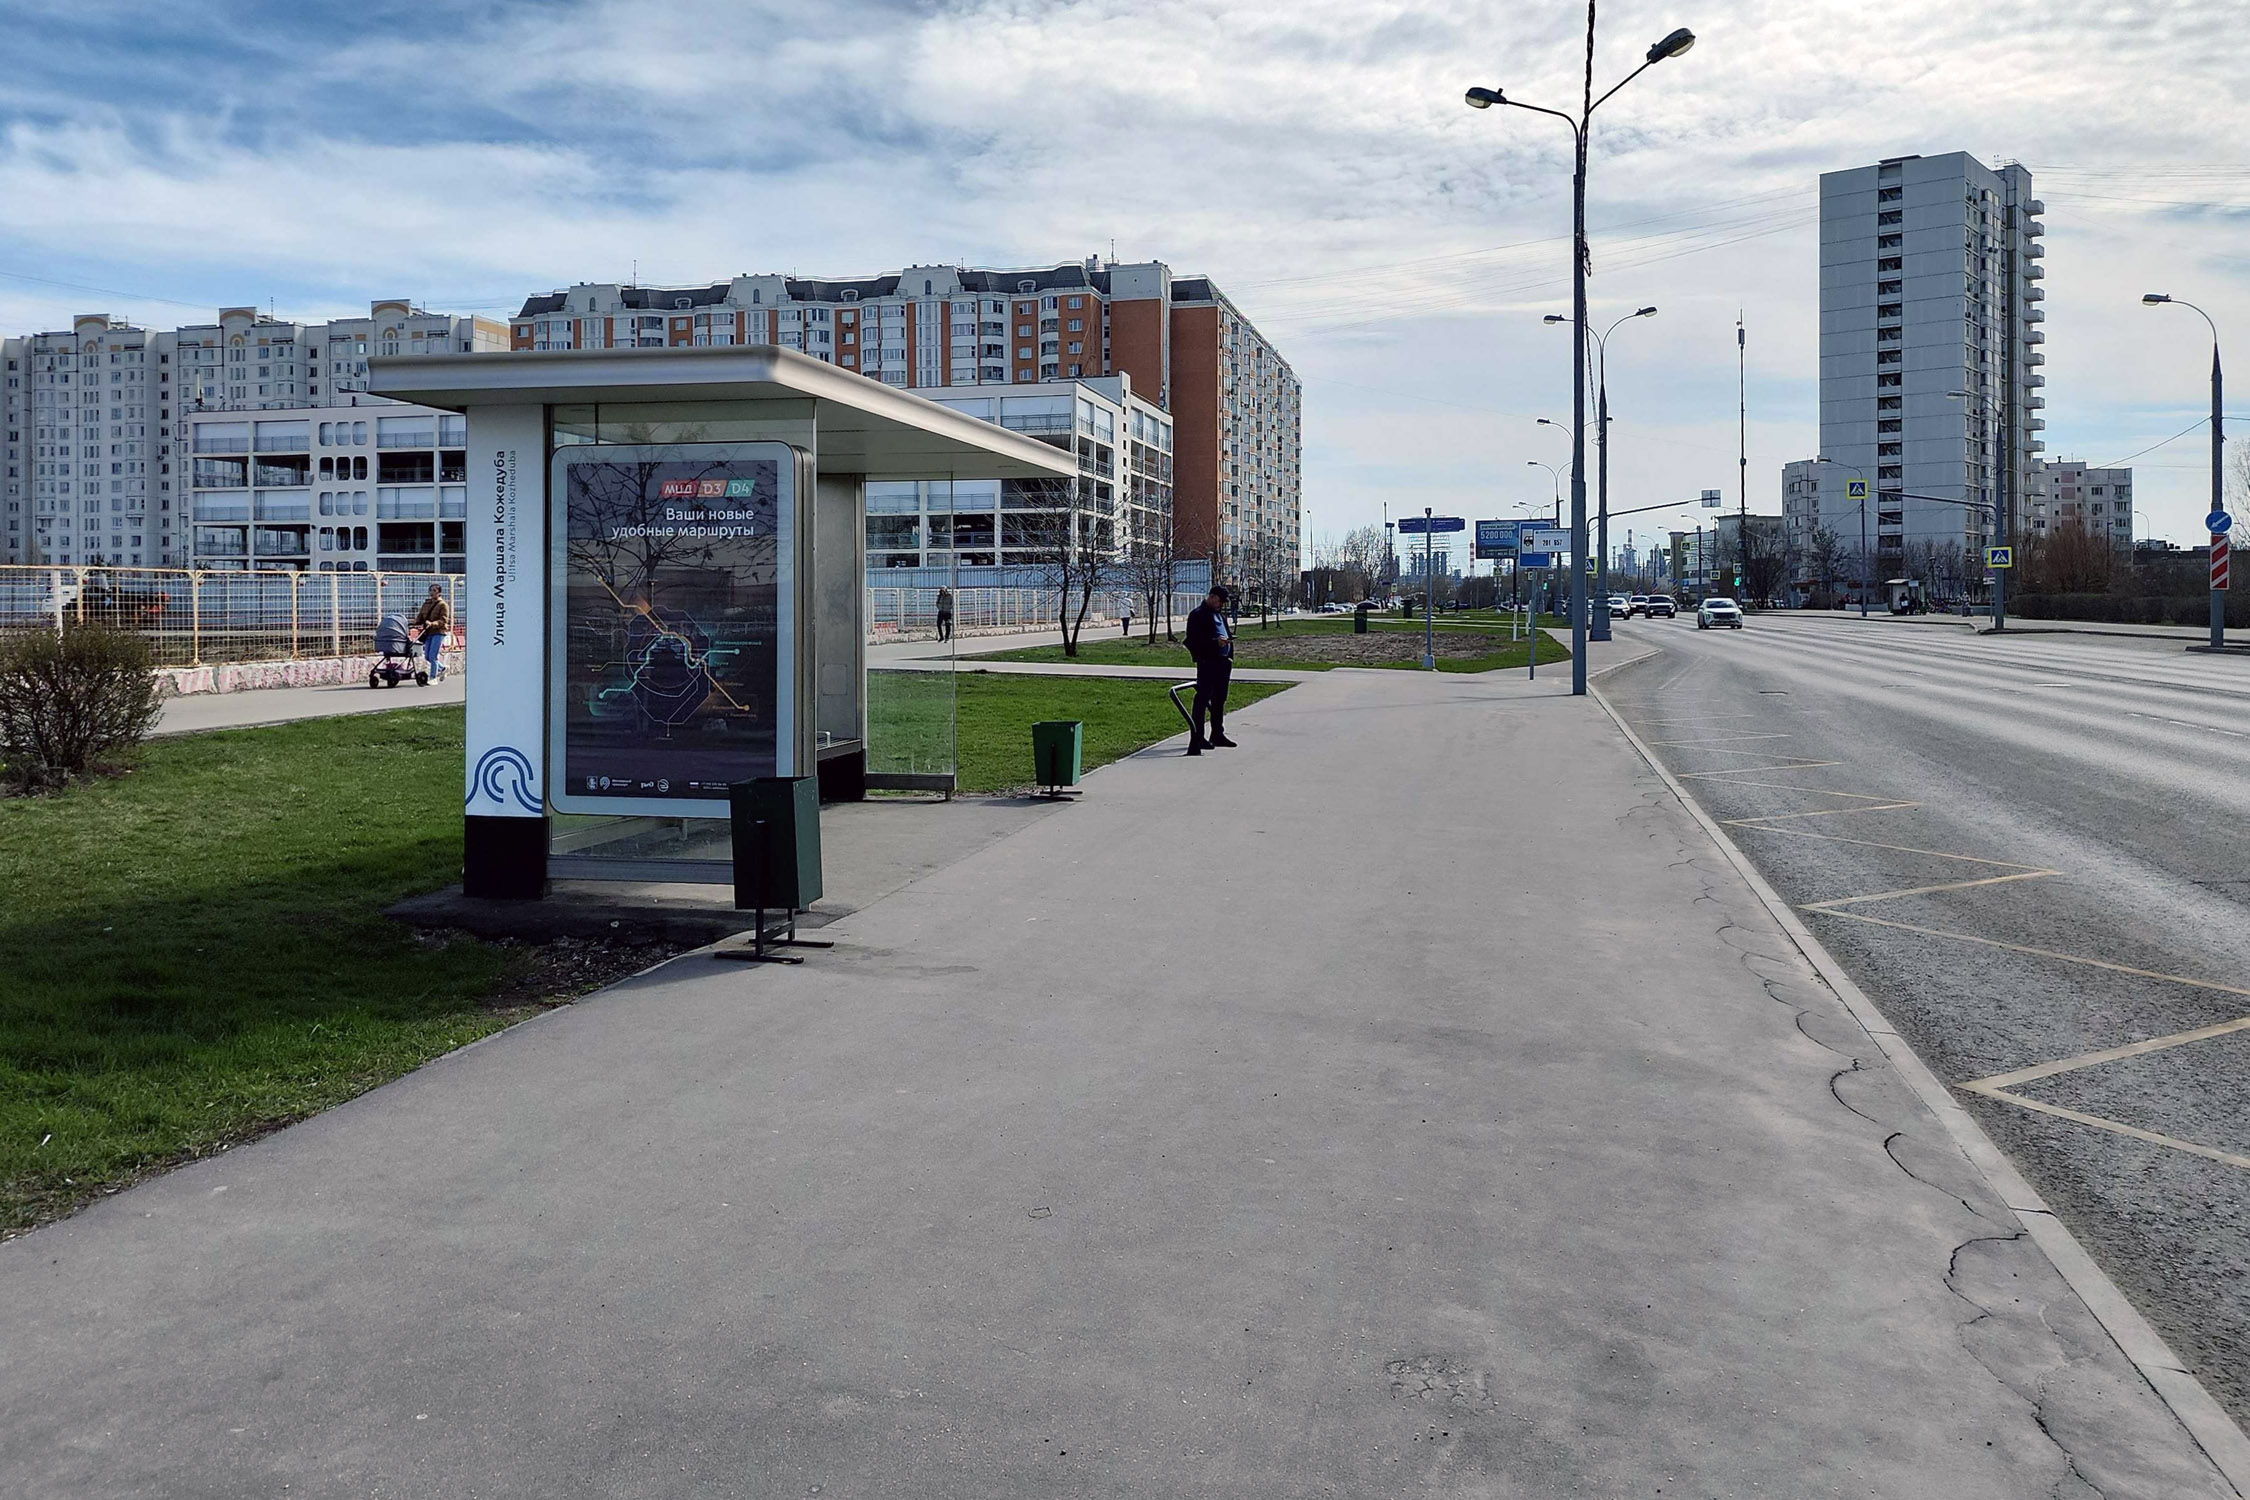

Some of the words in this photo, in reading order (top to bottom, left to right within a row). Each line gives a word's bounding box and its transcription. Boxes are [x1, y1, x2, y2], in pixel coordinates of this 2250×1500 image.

[494, 450, 507, 523] Кожедуба
[508, 450, 516, 504] Kozheduba
[664, 483, 693, 495] МЦД
[703, 483, 721, 494] D3
[731, 483, 750, 494] D4
[508, 507, 516, 552] Marshala
[611, 523, 674, 539] удобные
[678, 526, 754, 539] маршруты
[666, 507, 704, 521] Ваши
[709, 509, 754, 520] новые
[494, 528, 506, 598] Маршала
[508, 554, 516, 582] Ulitsa
[494, 602, 506, 646] Улица
